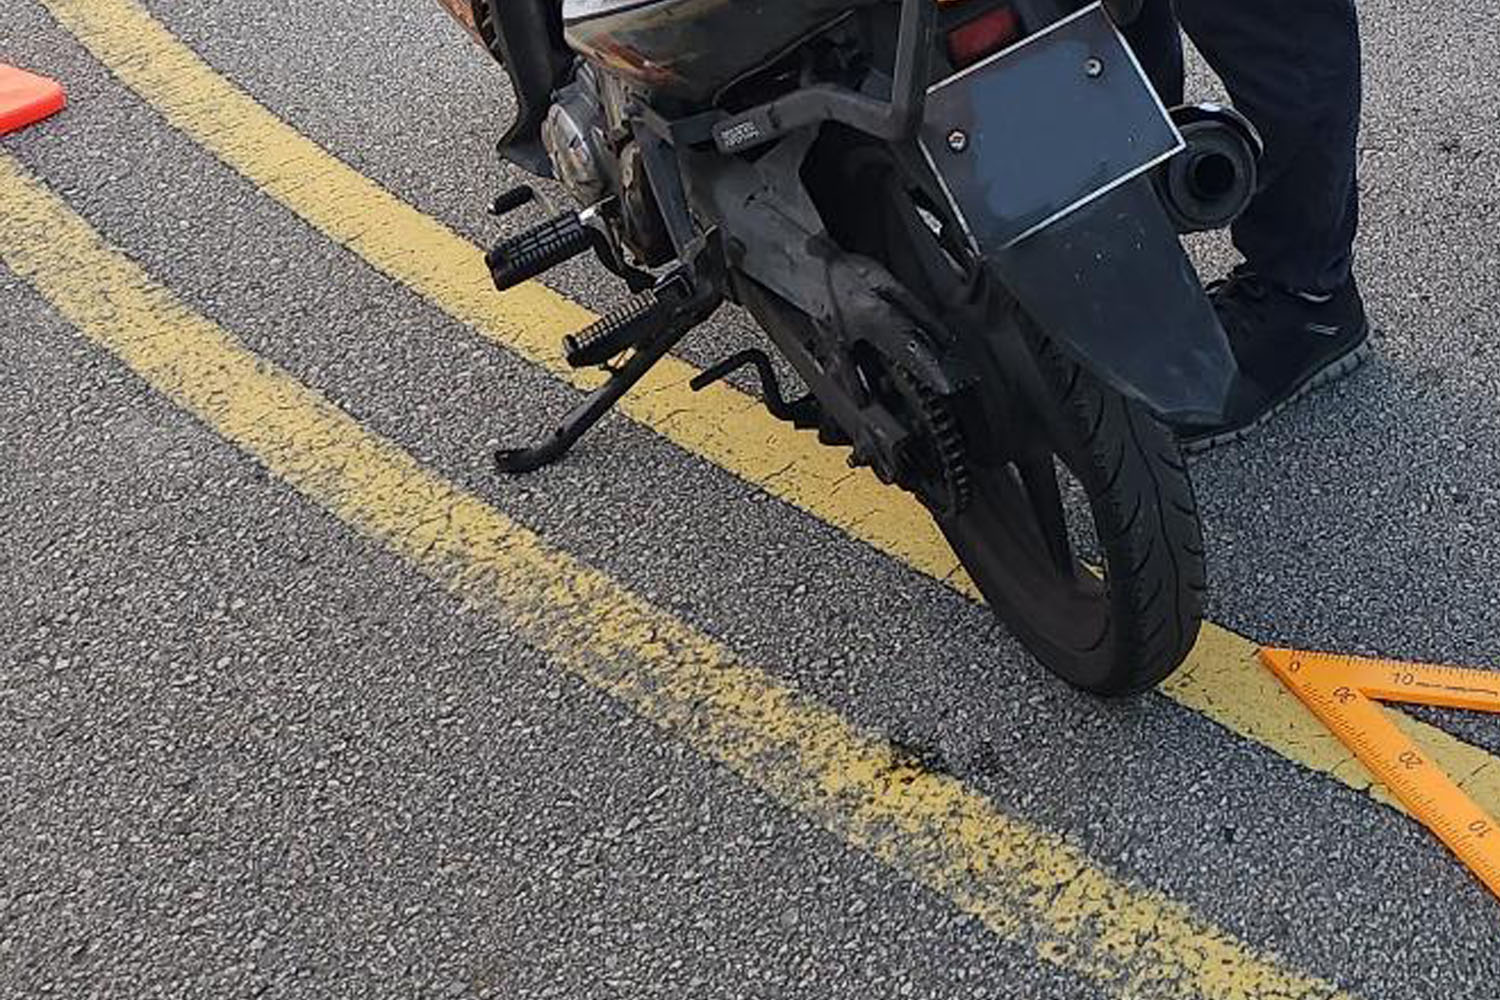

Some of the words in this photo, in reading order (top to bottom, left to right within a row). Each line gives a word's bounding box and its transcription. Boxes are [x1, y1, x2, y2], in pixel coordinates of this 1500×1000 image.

[1289, 661, 1301, 673] 0
[1393, 672, 1415, 687] 10
[1399, 750, 1424, 770] 20
